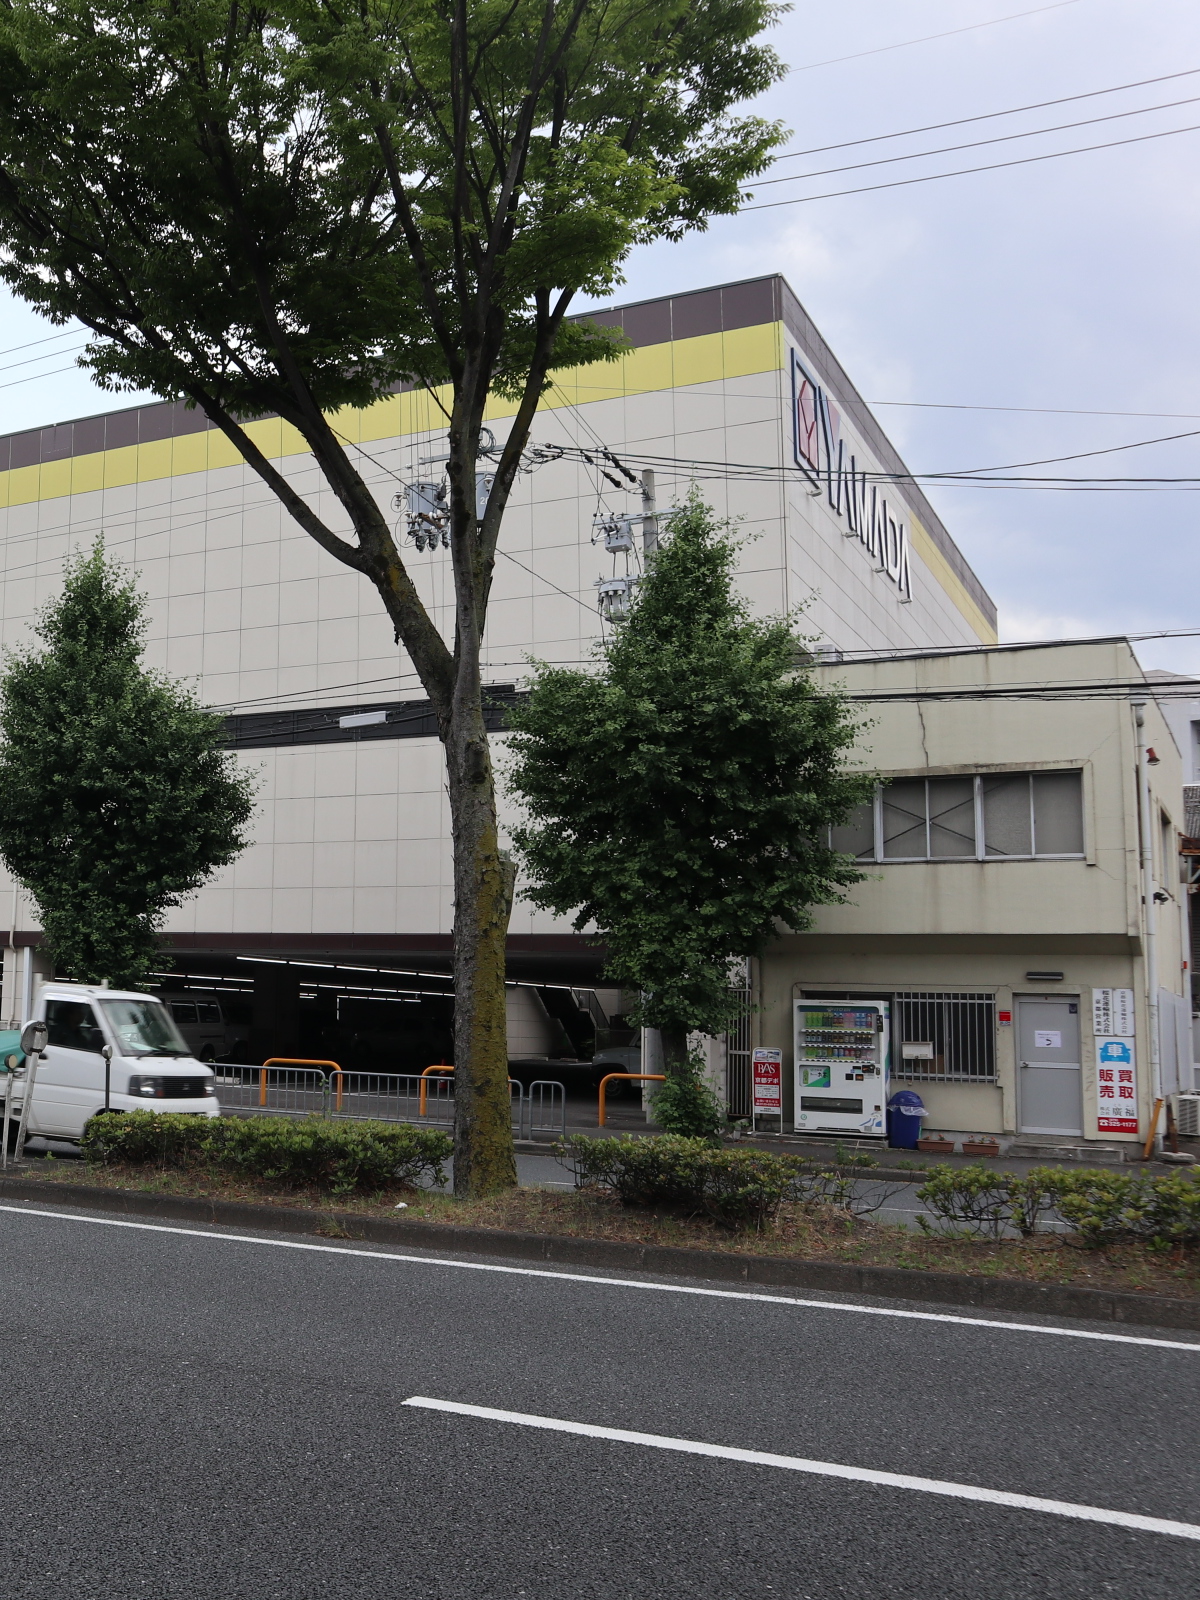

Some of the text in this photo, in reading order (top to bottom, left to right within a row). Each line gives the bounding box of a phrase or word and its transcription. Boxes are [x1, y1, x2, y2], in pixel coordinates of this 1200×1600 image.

[818, 385, 913, 602] YAMADA
[1106, 1043, 1124, 1058] 車
[757, 1063, 776, 1074] BAS
